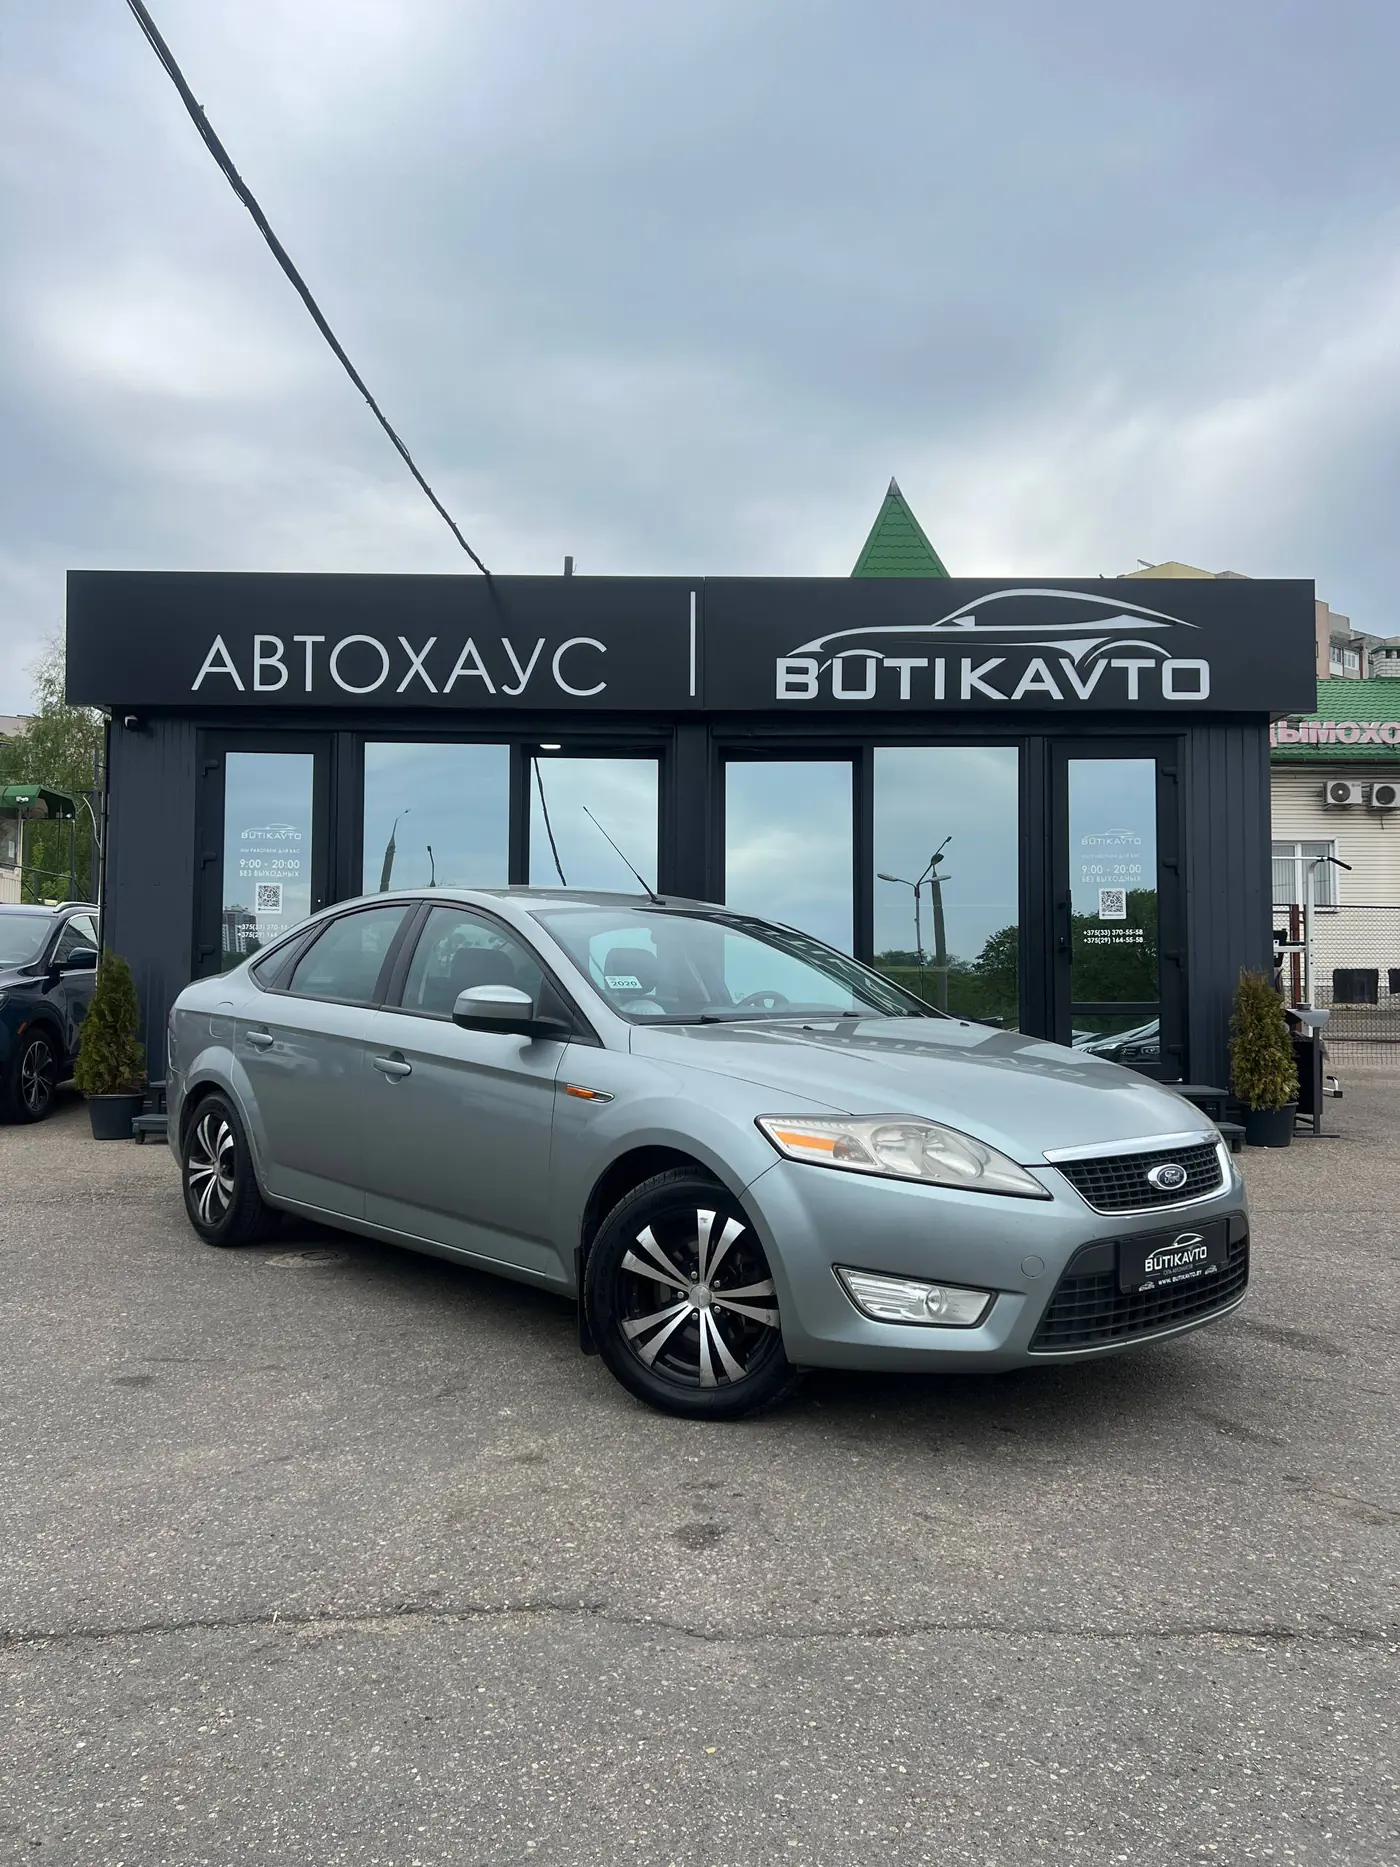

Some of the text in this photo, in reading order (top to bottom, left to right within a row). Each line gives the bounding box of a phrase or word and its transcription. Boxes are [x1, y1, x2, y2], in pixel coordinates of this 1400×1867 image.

[191, 634, 607, 696] АВТОХАУС
[776, 657, 1211, 700] BUTIKAVTO
[241, 831, 302, 840] BUTIKAVTO
[1081, 837, 1142, 845] BUTIKAVTO
[240, 859, 261, 869] 9:00
[272, 859, 300, 869] 20:00
[1081, 865, 1103, 874] 9:00
[1113, 864, 1141, 874] 20:00
[1083, 929, 1111, 937] +375(33)
[1083, 937, 1111, 945] +375(29)
[1164, 1170, 1180, 1184] Ford
[1145, 1246, 1207, 1272] BUTIKAVTO
